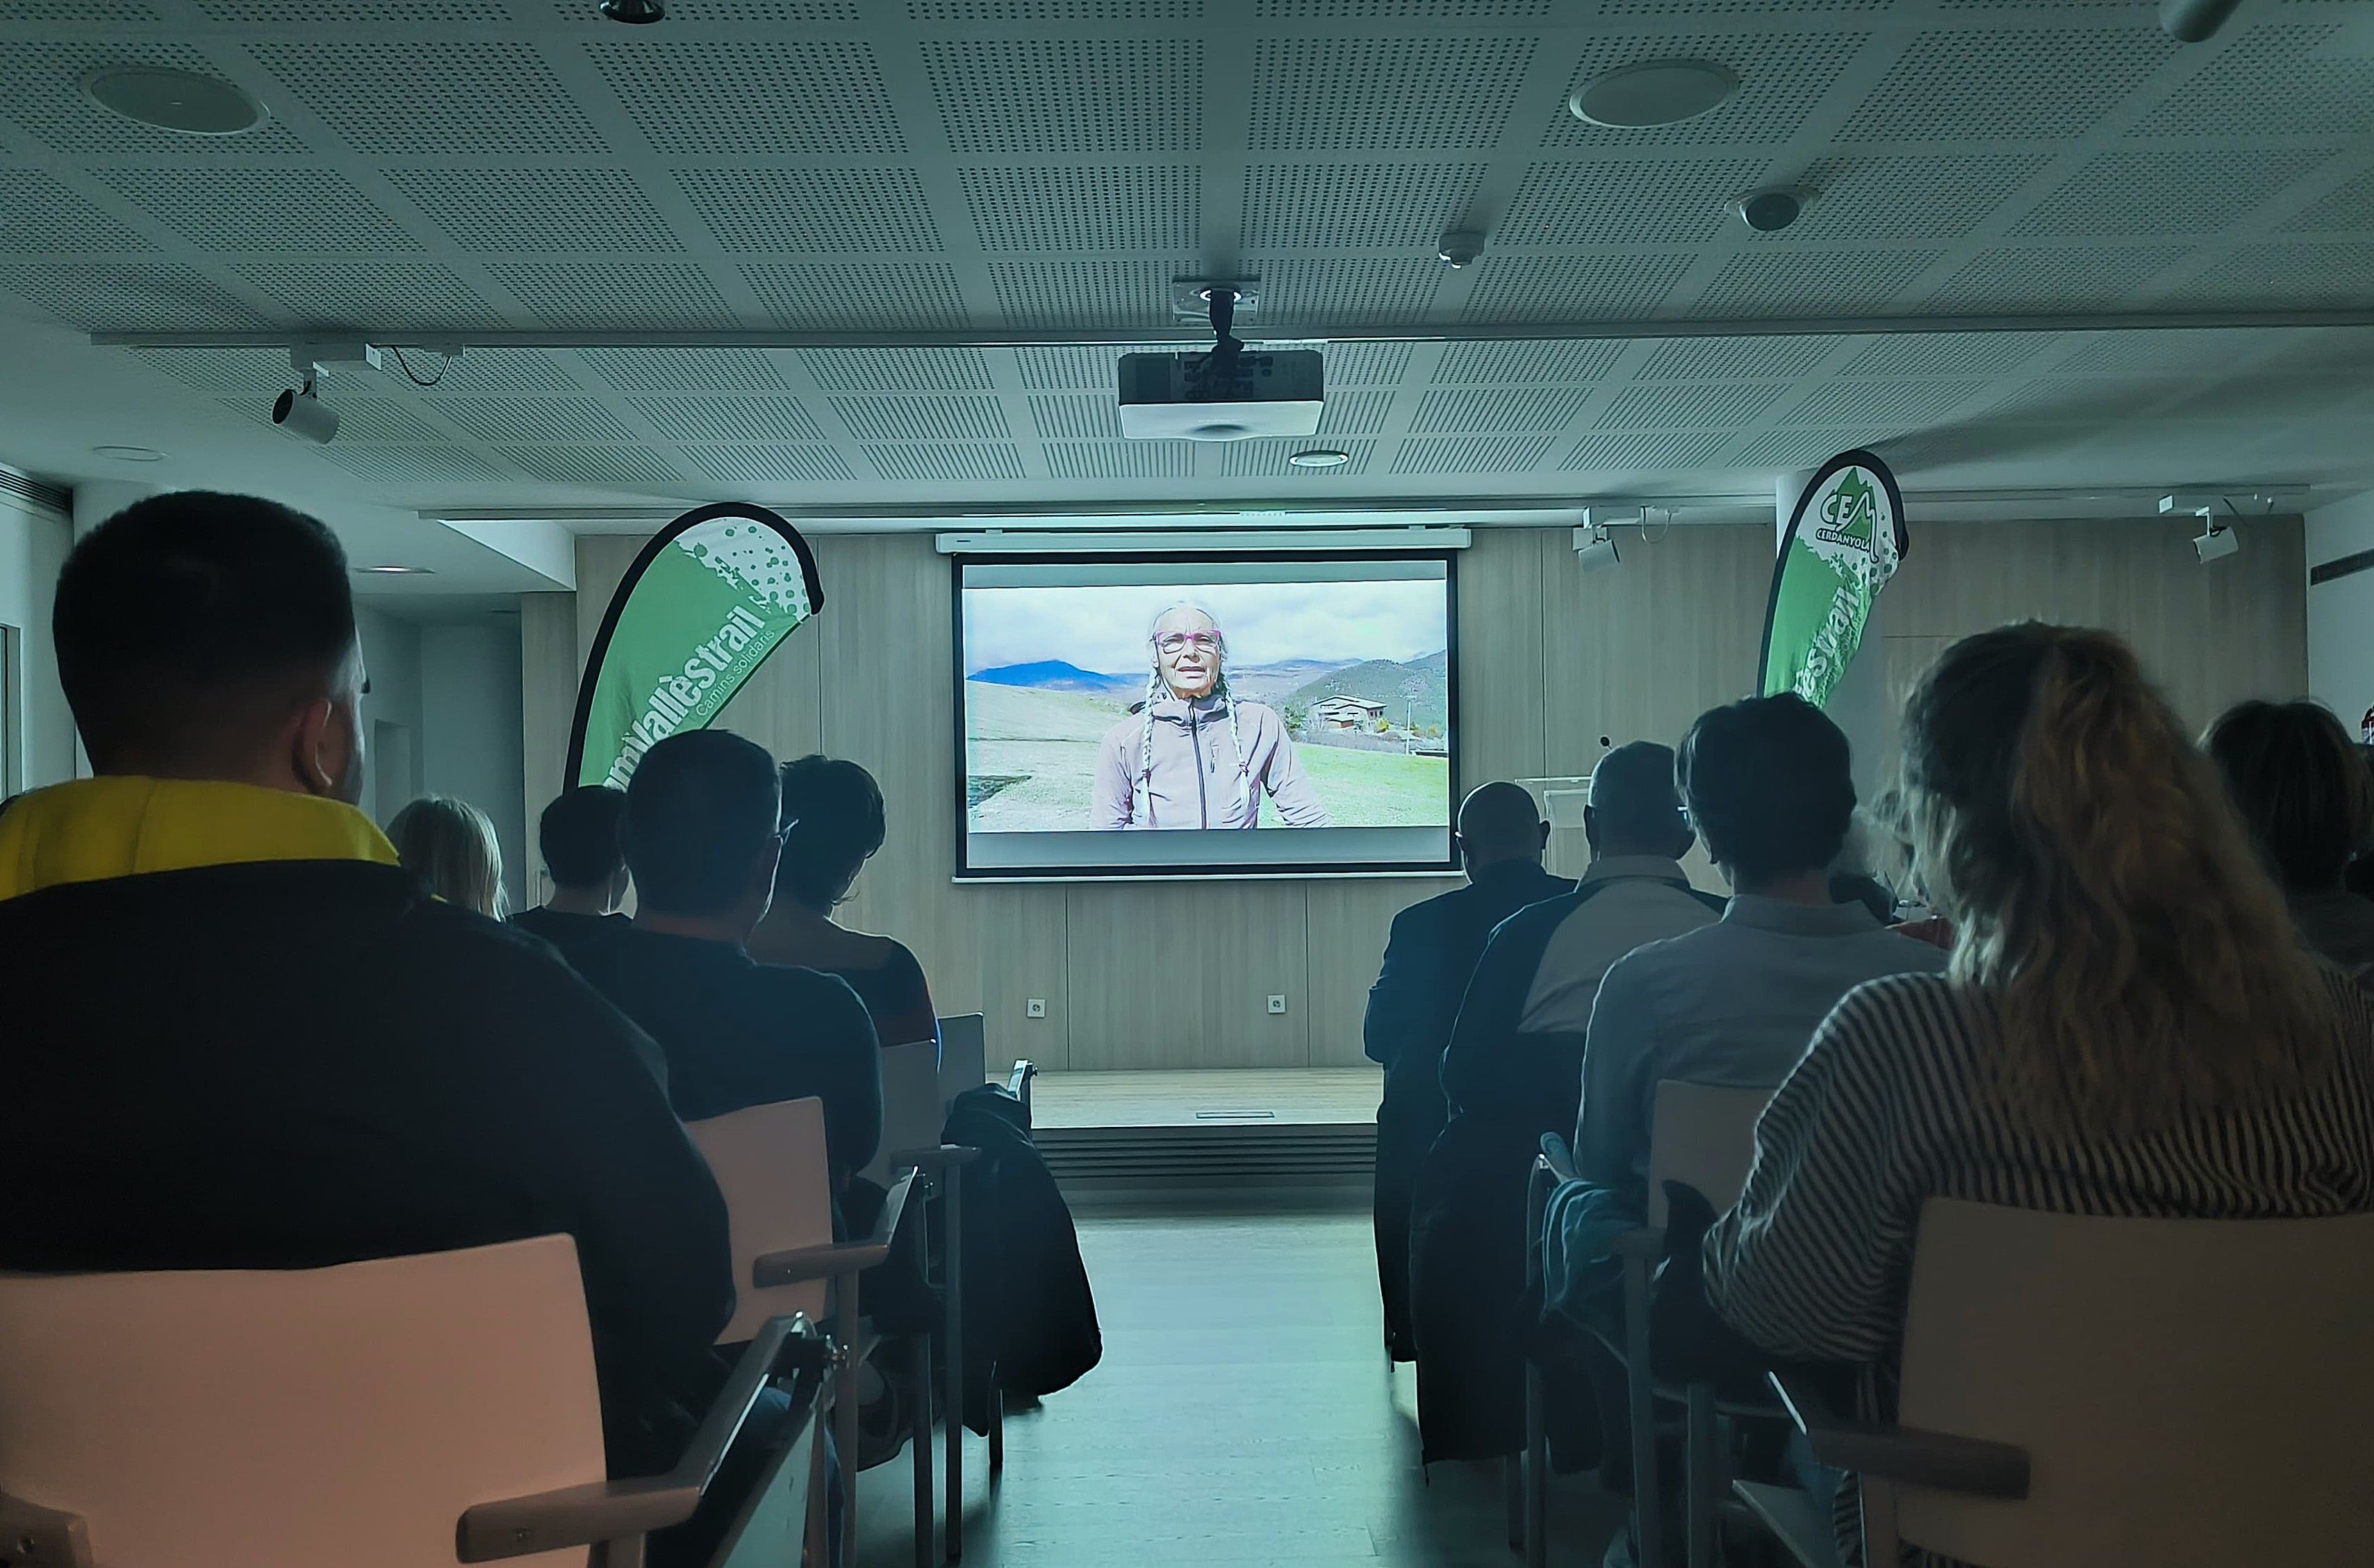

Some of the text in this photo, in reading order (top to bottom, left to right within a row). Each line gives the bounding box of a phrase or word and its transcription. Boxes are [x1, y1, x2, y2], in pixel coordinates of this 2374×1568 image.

[1816, 529, 1870, 552] CERDANYOLA
[696, 629, 775, 716] Camins solidaris
